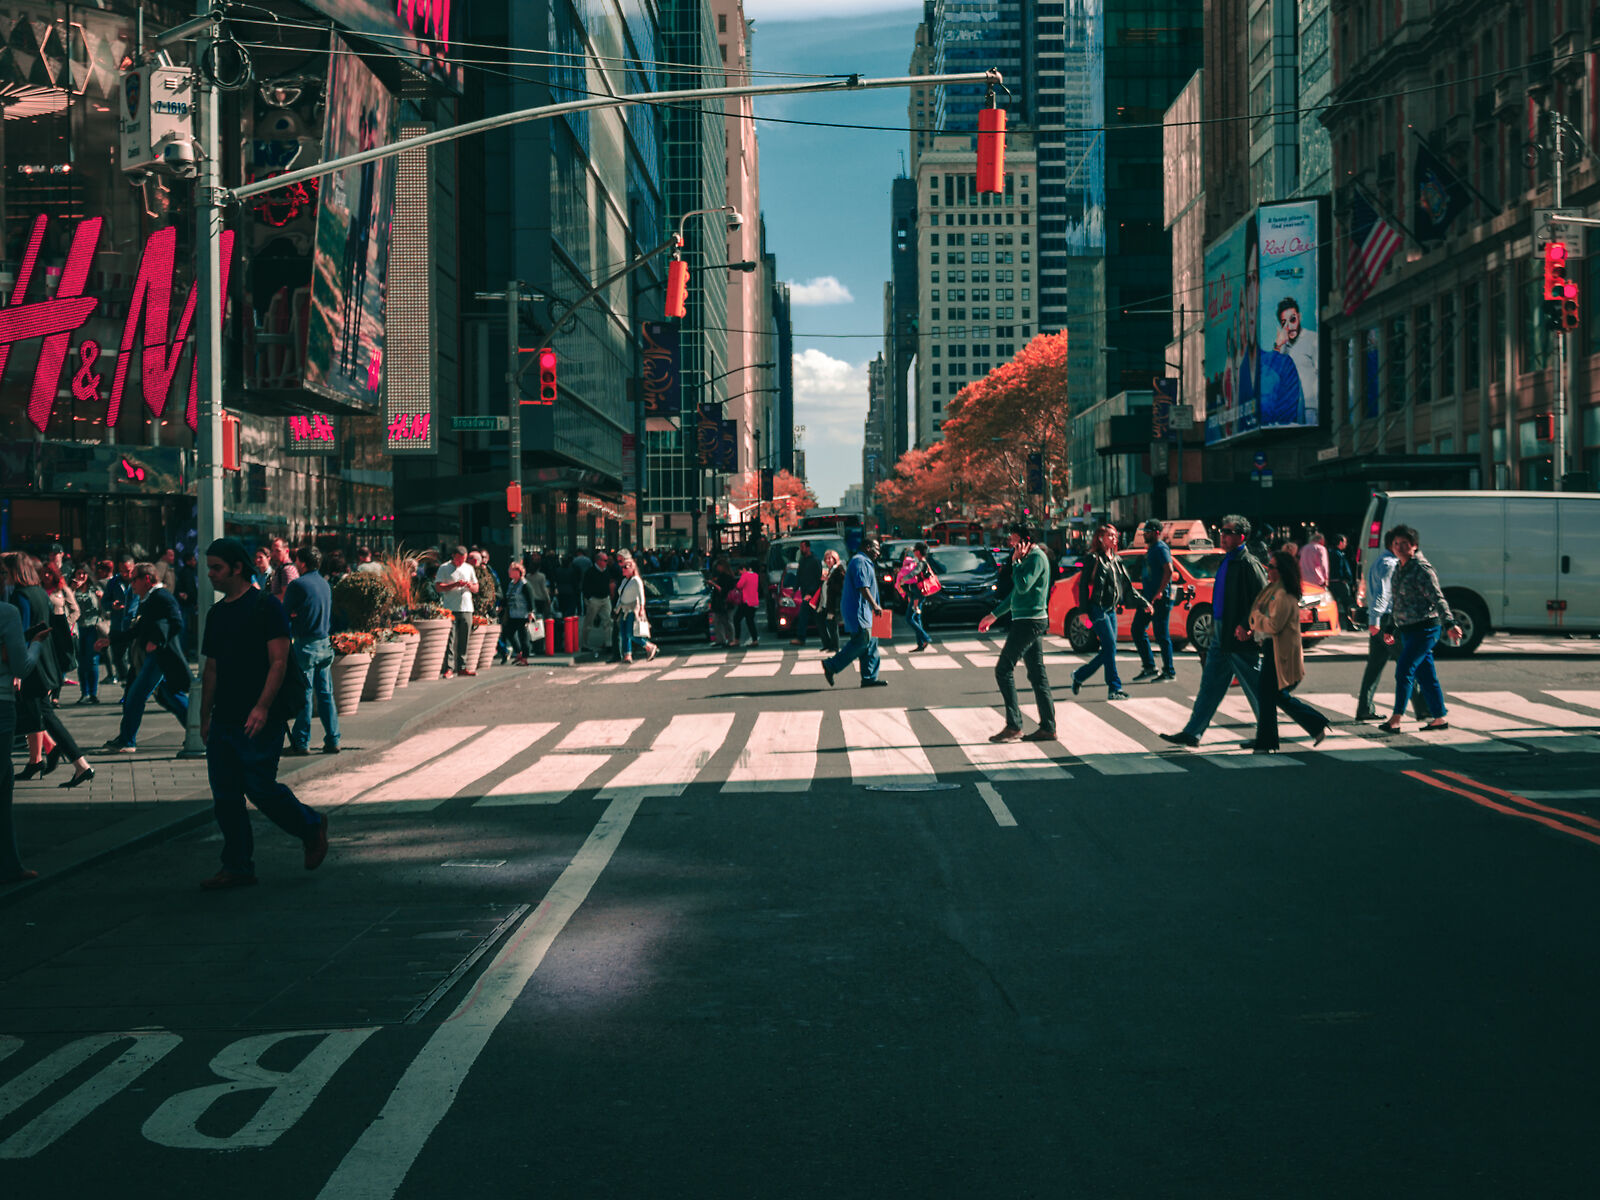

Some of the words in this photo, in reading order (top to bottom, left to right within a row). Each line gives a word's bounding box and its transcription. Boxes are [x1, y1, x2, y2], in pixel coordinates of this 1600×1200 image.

[157, 101, 187, 114] 7-1613
[1262, 239, 1287, 256] Red
[0, 213, 235, 433] H&M
[387, 413, 430, 441] H&M
[453, 417, 495, 430] Broadway
[0, 1026, 383, 1158] BU
